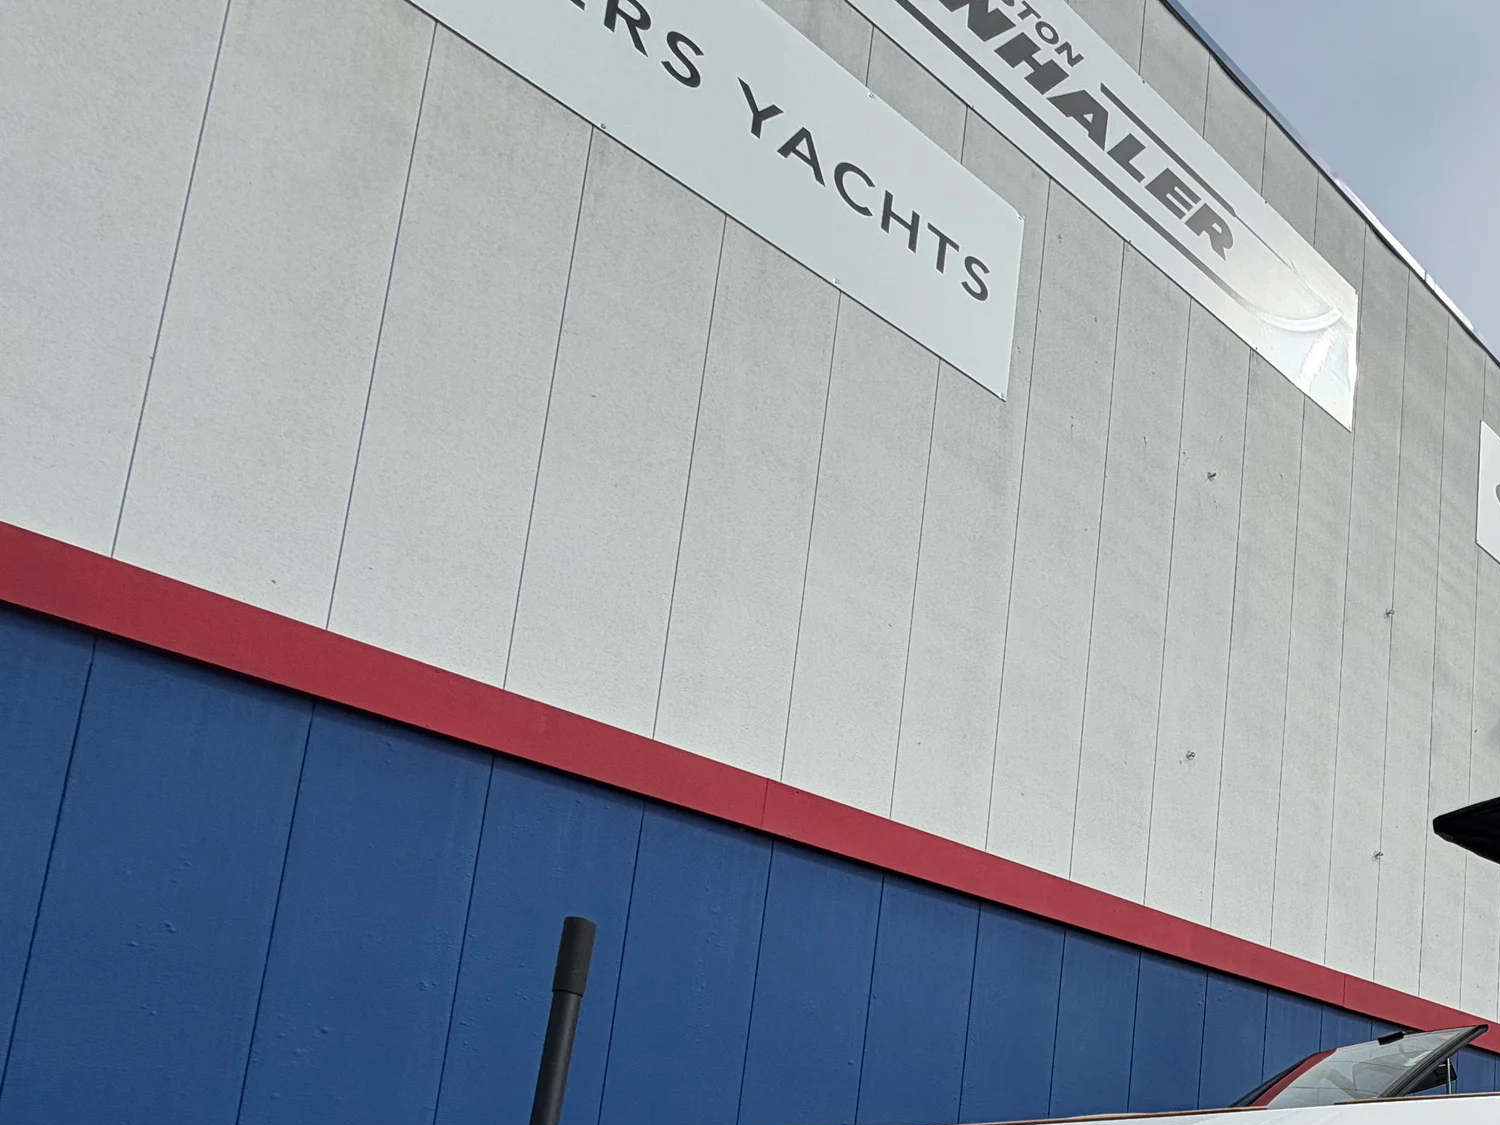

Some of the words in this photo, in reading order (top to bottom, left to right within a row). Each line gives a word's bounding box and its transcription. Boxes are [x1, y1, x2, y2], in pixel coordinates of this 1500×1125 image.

[1002, 0, 1085, 68] TON
[570, 0, 704, 88] RS
[737, 77, 991, 302] YACHTS
